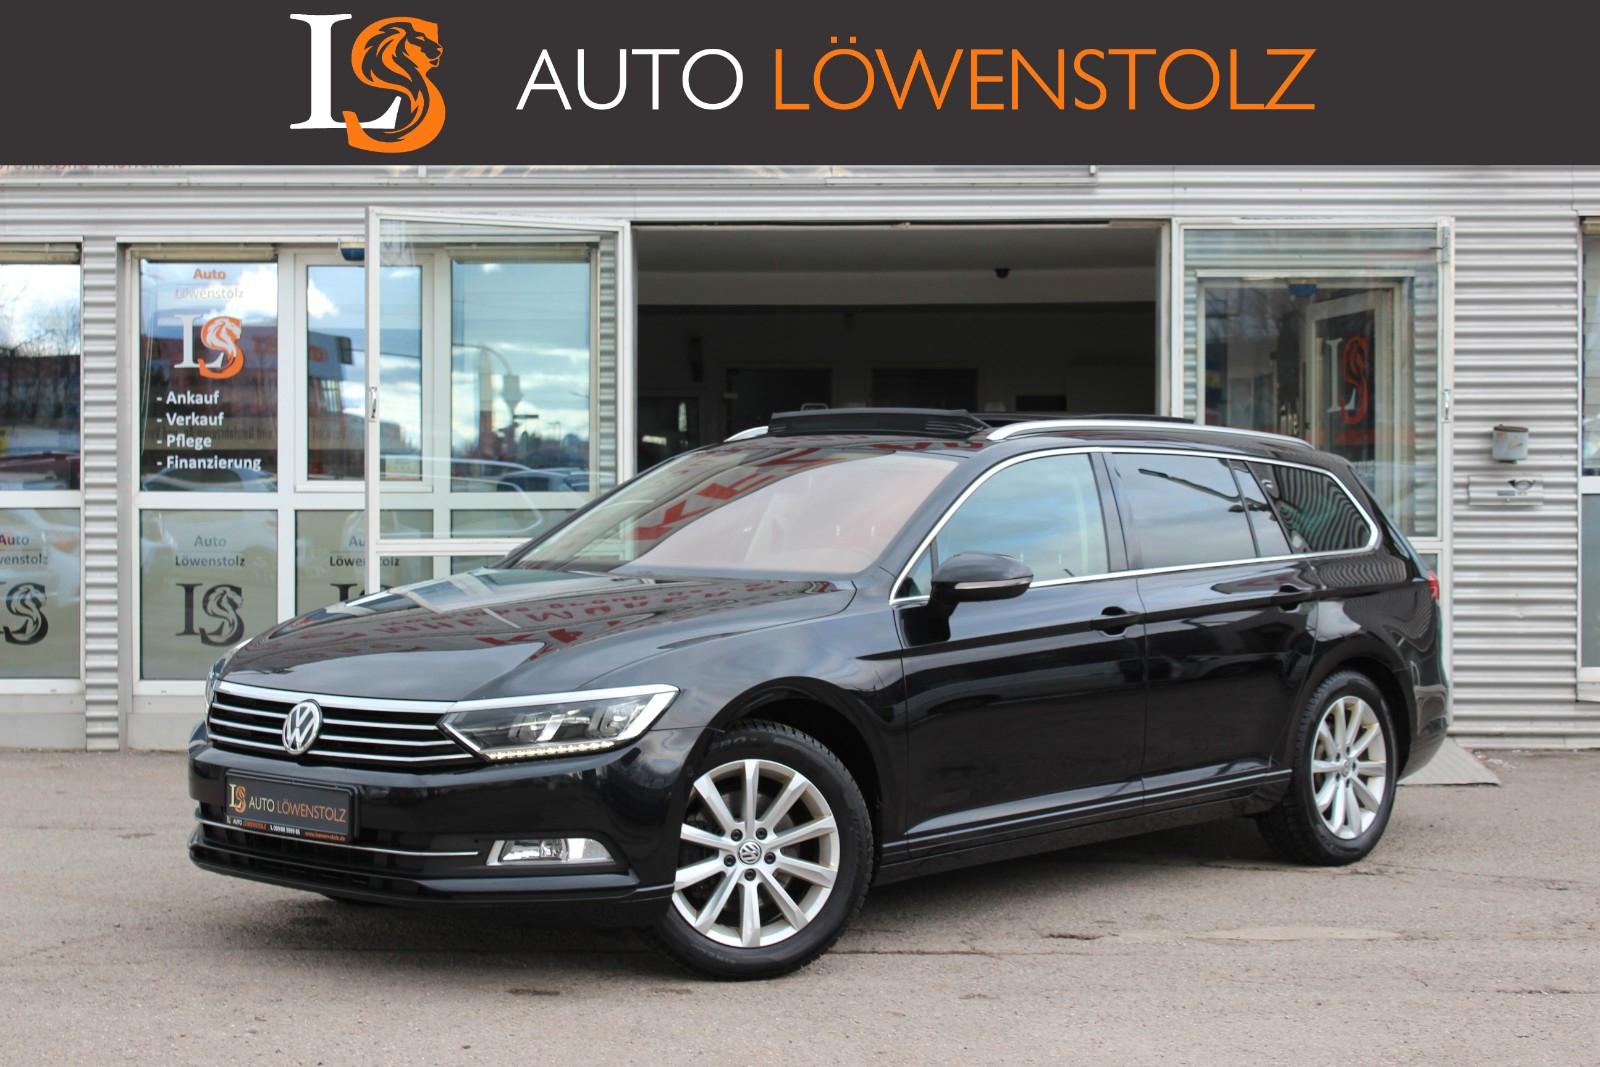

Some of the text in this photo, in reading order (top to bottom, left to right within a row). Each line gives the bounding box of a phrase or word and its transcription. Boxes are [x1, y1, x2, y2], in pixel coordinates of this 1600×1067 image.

[193, 268, 227, 280] Auto
[174, 314, 245, 379] LS
[166, 390, 220, 405] Ankauf
[166, 412, 225, 426] Verkauf
[166, 433, 212, 450] Pflege
[166, 455, 262, 472] Finanzierung
[193, 535, 227, 548] Auto
[348, 535, 366, 547] Au
[0, 553, 49, 566] enstolz
[175, 555, 245, 568] Löwenstolz
[175, 582, 245, 647] LS
[249, 795, 275, 813] AUTO
[277, 797, 347, 823] LÖWENSTOLZ
